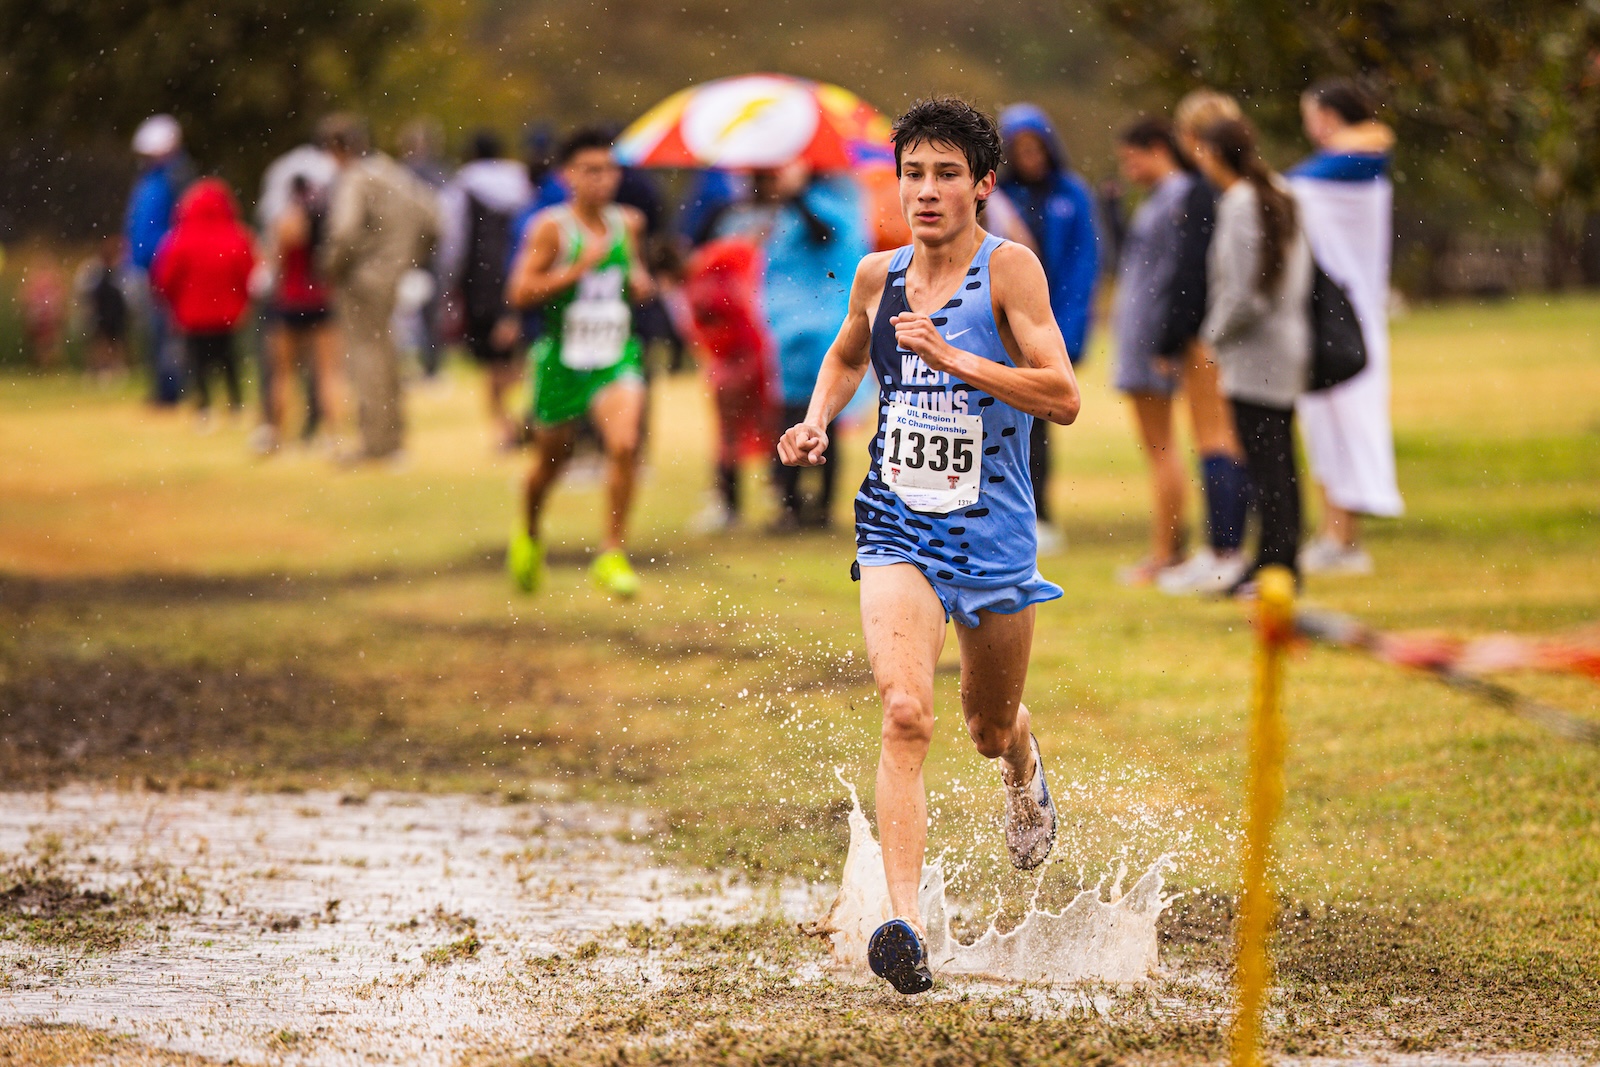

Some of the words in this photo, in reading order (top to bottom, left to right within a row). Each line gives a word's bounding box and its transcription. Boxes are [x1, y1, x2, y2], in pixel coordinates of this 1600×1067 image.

[896, 416, 907, 425] XC
[908, 418, 967, 435] Championship
[906, 409, 920, 418] UIL
[922, 412, 951, 423] Region
[888, 427, 974, 474] 1335
